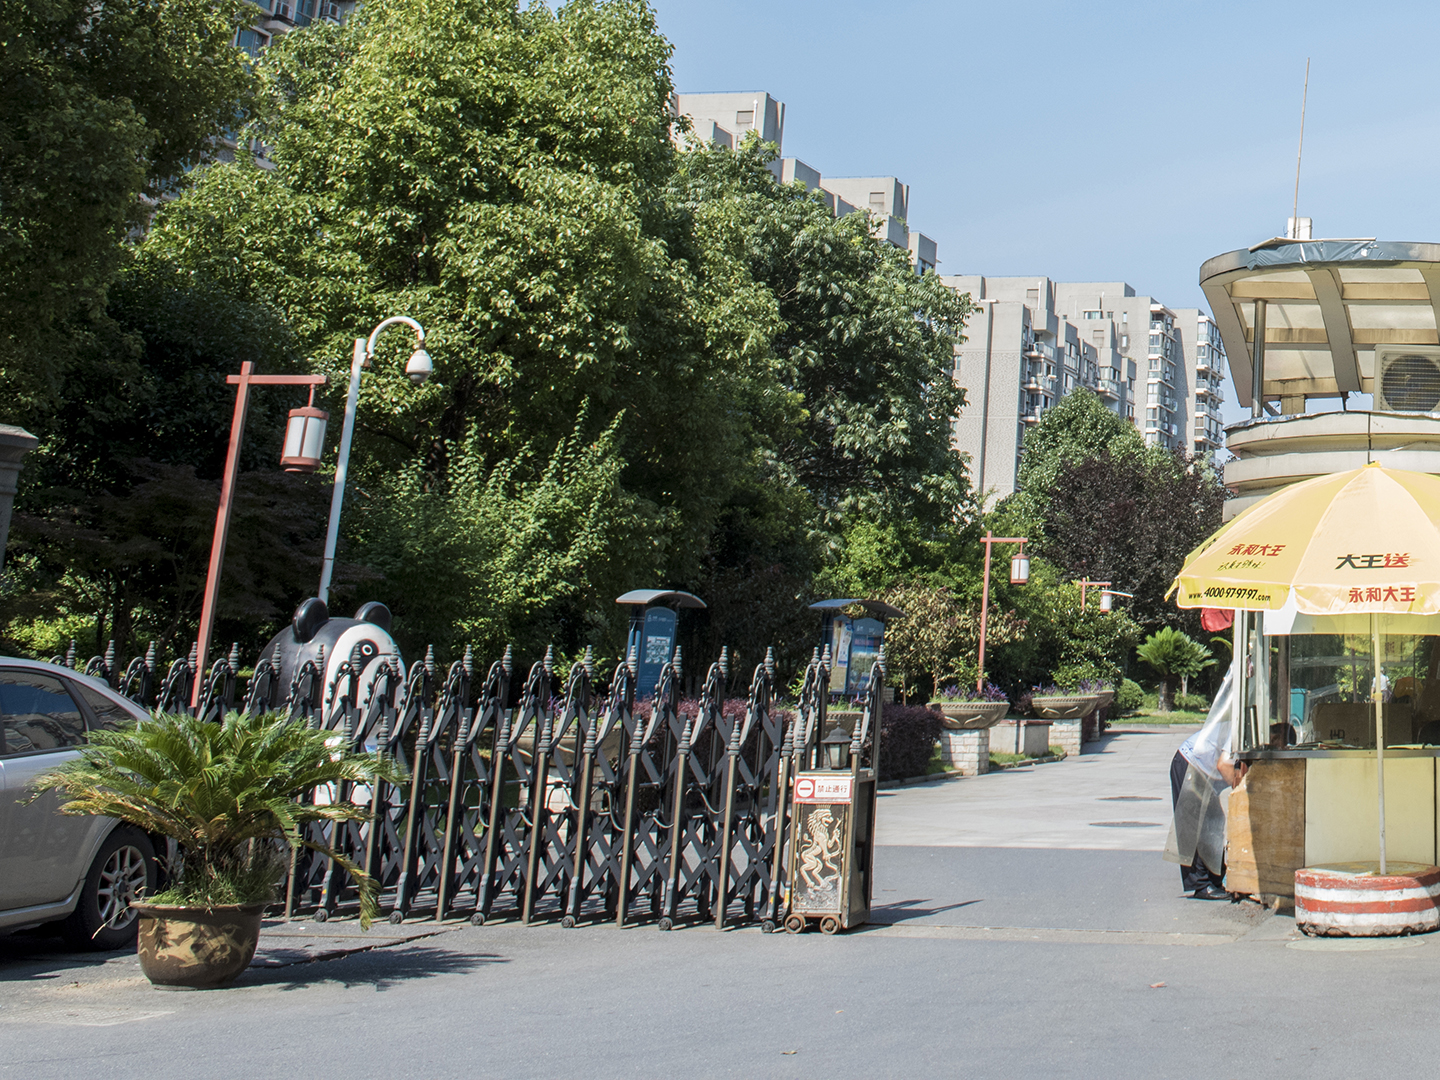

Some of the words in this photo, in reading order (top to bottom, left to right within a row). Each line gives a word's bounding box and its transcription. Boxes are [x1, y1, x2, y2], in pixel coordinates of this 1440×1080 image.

[1226, 543, 1287, 557] 永和大王
[1334, 552, 1410, 570] 大王送
[1348, 586, 1416, 604] 永和大王
[817, 784, 848, 793] 禁止通行
